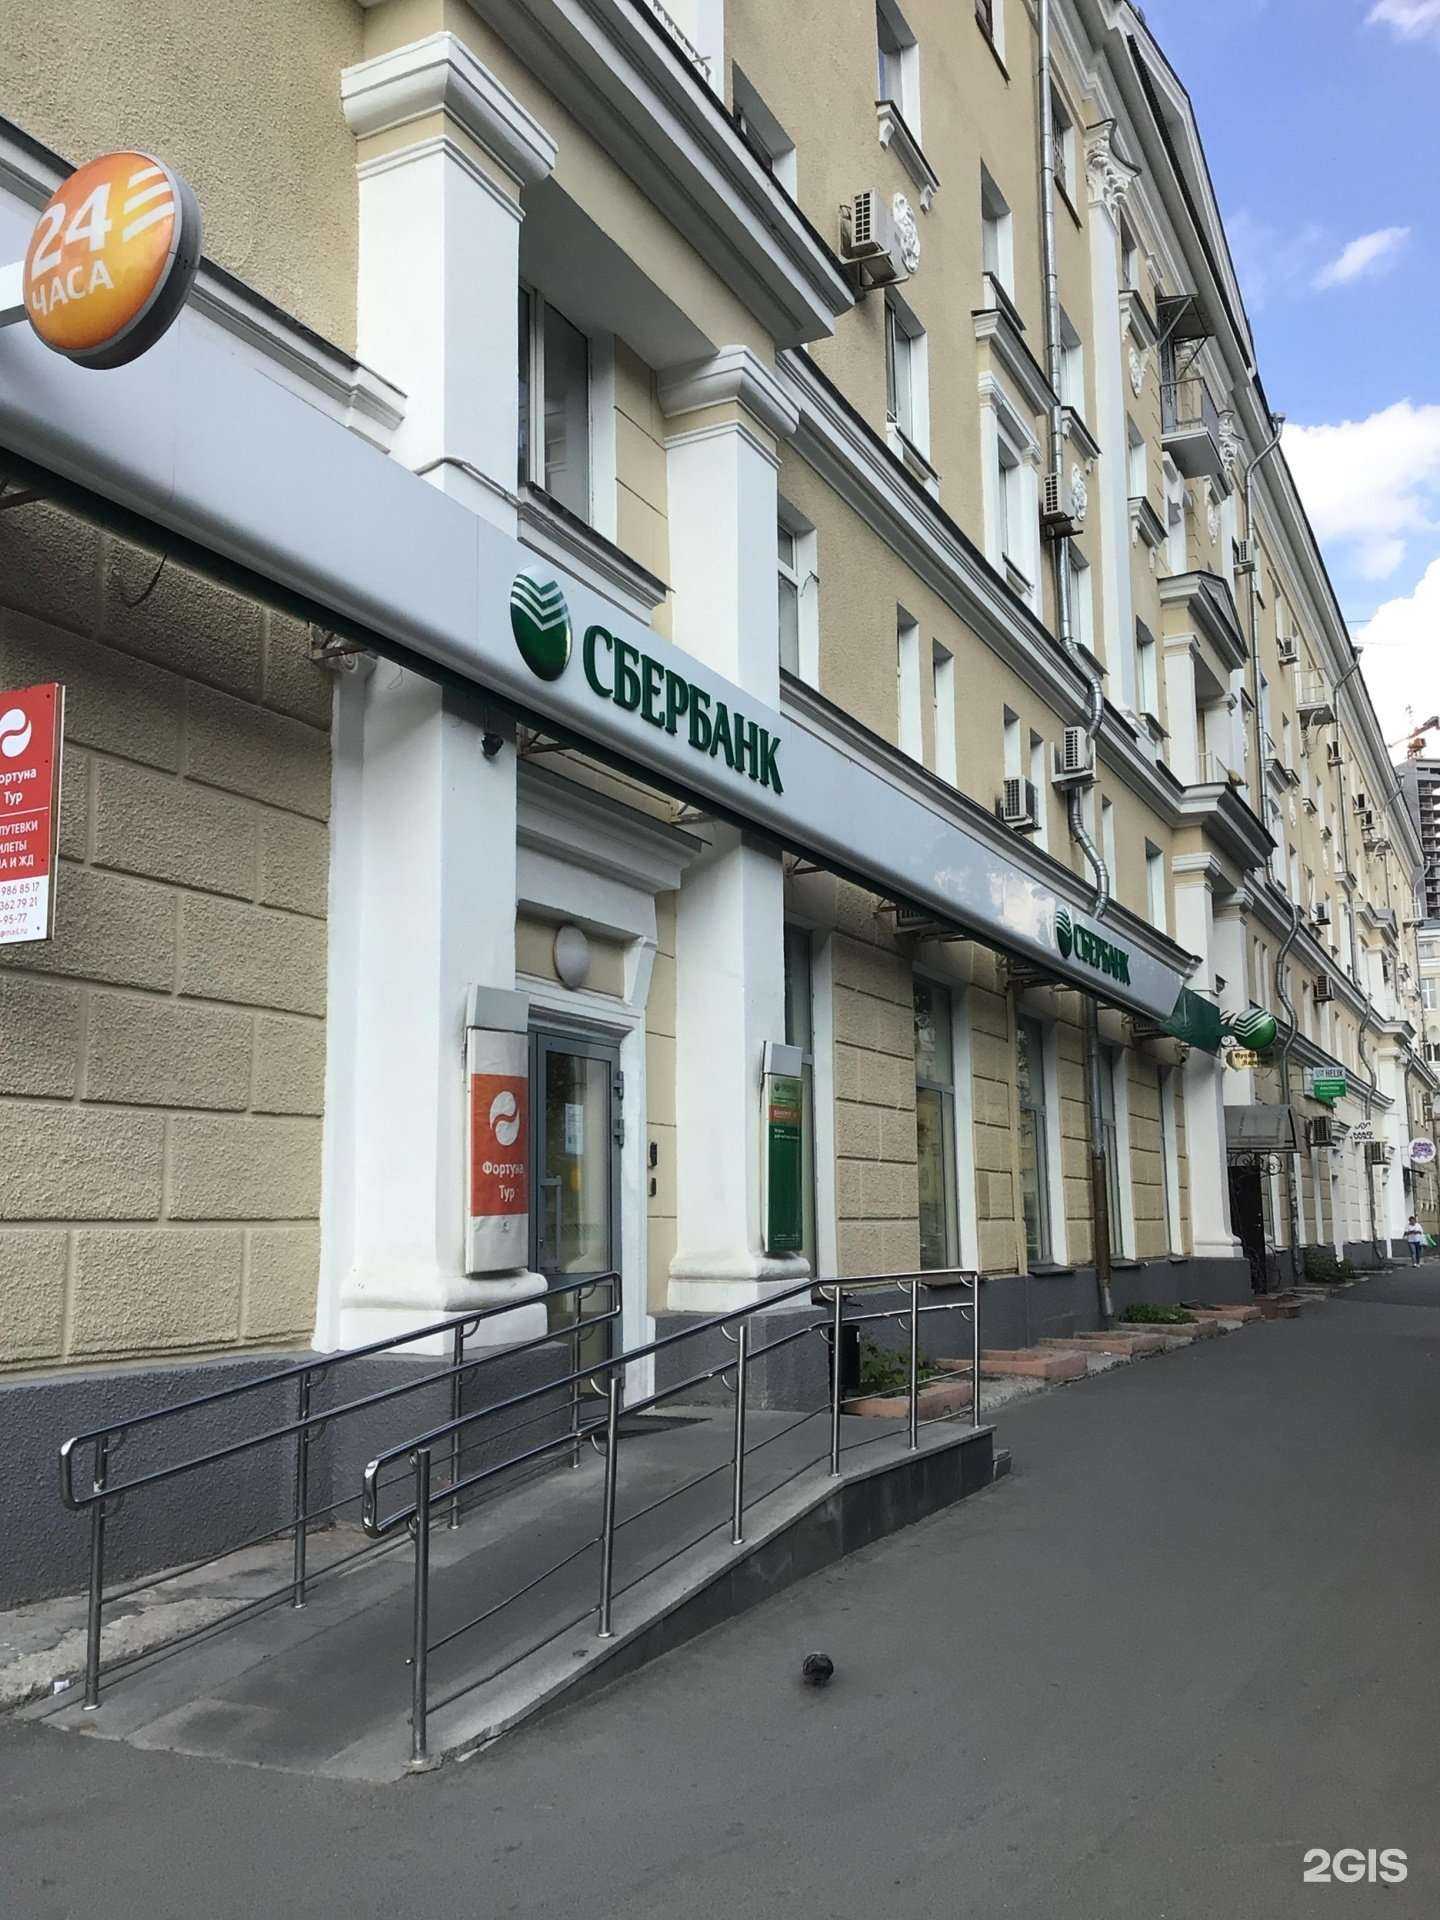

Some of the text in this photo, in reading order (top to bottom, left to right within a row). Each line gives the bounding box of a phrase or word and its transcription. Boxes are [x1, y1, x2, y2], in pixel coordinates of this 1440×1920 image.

[31, 182, 112, 281] 24
[31, 259, 114, 316] ЧАСА
[582, 624, 784, 796] СБЕРБАНК
[4, 790, 23, 806] Тур
[0, 819, 38, 836] ПУТЕВКИ
[10, 856, 17, 868] И
[18, 854, 34, 867] ЖД
[482, 1160, 525, 1178] Фортуна
[498, 1184, 515, 1202] Тур
